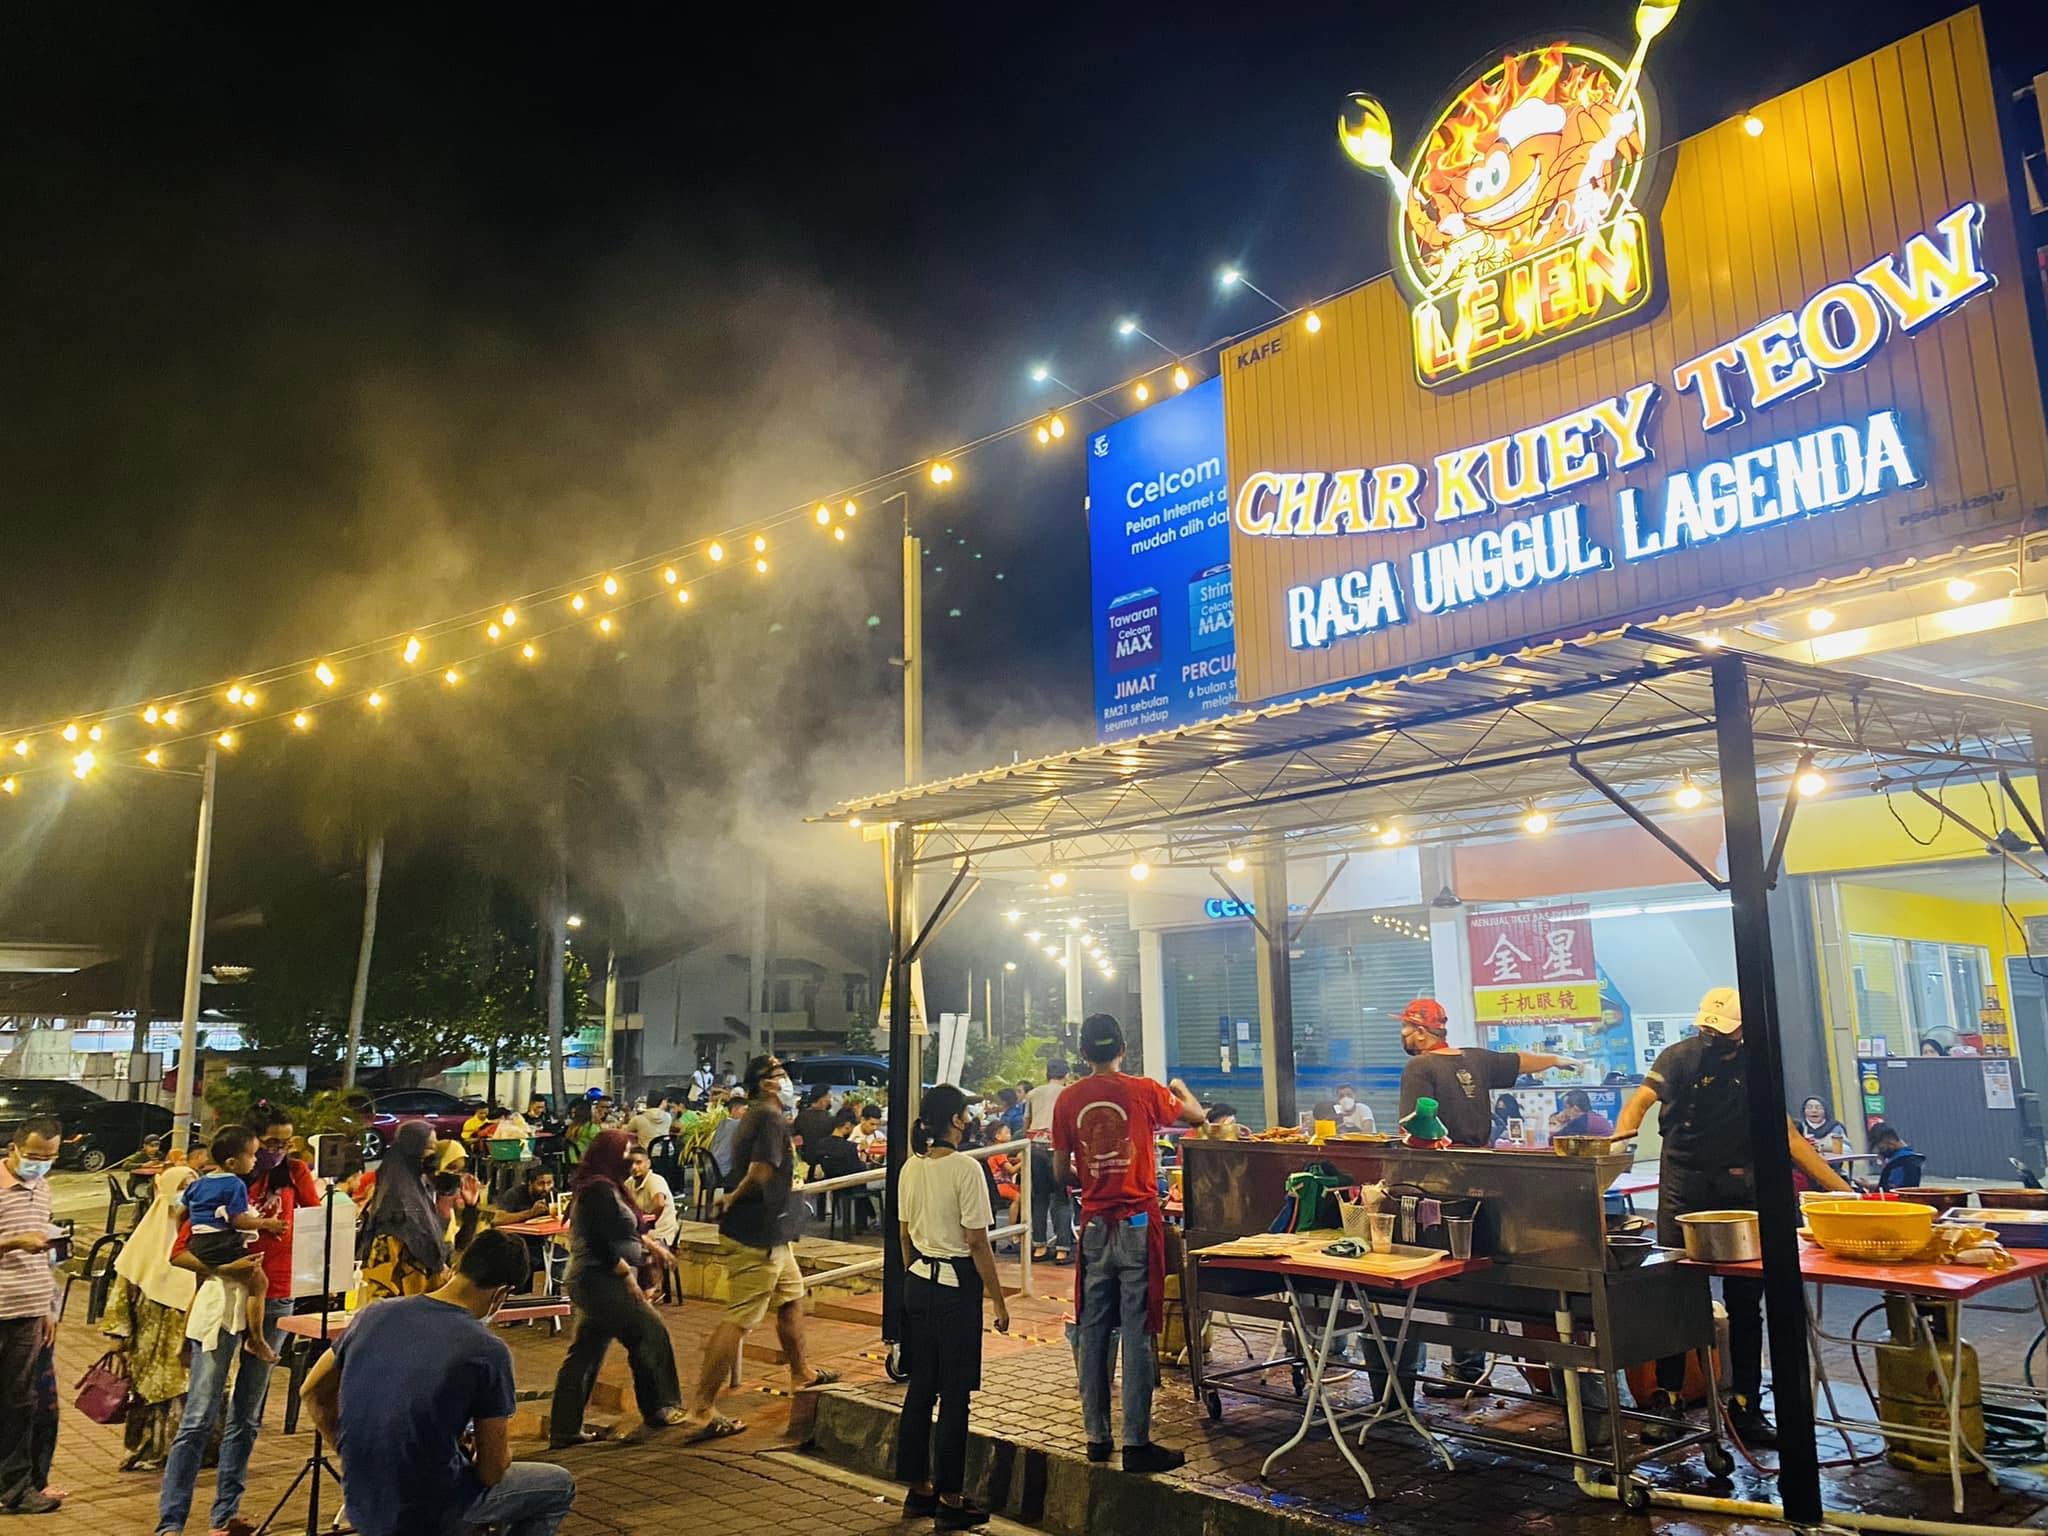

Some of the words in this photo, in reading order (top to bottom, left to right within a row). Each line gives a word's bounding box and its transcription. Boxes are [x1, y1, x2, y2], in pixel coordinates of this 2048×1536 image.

[1415, 216, 1642, 374] LEJEN
[1236, 338, 1282, 370] KAFE
[1236, 463, 1425, 537] CHAR
[1434, 381, 1658, 522] KUEY
[1674, 202, 1994, 432] TEOW
[1126, 457, 1221, 509] Celcom
[1125, 514, 1161, 536] Pelan
[1163, 491, 1214, 522] Internet
[1131, 528, 1177, 555] mudah
[1179, 518, 1204, 538] alih
[1288, 562, 1406, 649] RASA
[1411, 503, 1609, 614] UNGGUL
[1619, 410, 1922, 560] LAGENDA
[1109, 606, 1158, 629] Tawaran
[1118, 624, 1151, 640] Celcom
[1116, 632, 1153, 658] MAX
[1114, 674, 1157, 699] JIMAT
[1196, 681, 1226, 697] bulan
[1104, 704, 1128, 719] RM21
[1131, 695, 1168, 712] sebulan
[1105, 716, 1138, 732] seumur
[1141, 710, 1168, 724] hidup
[1483, 927, 1585, 982] 金星
[1496, 989, 1579, 1013] 手机眼镜
